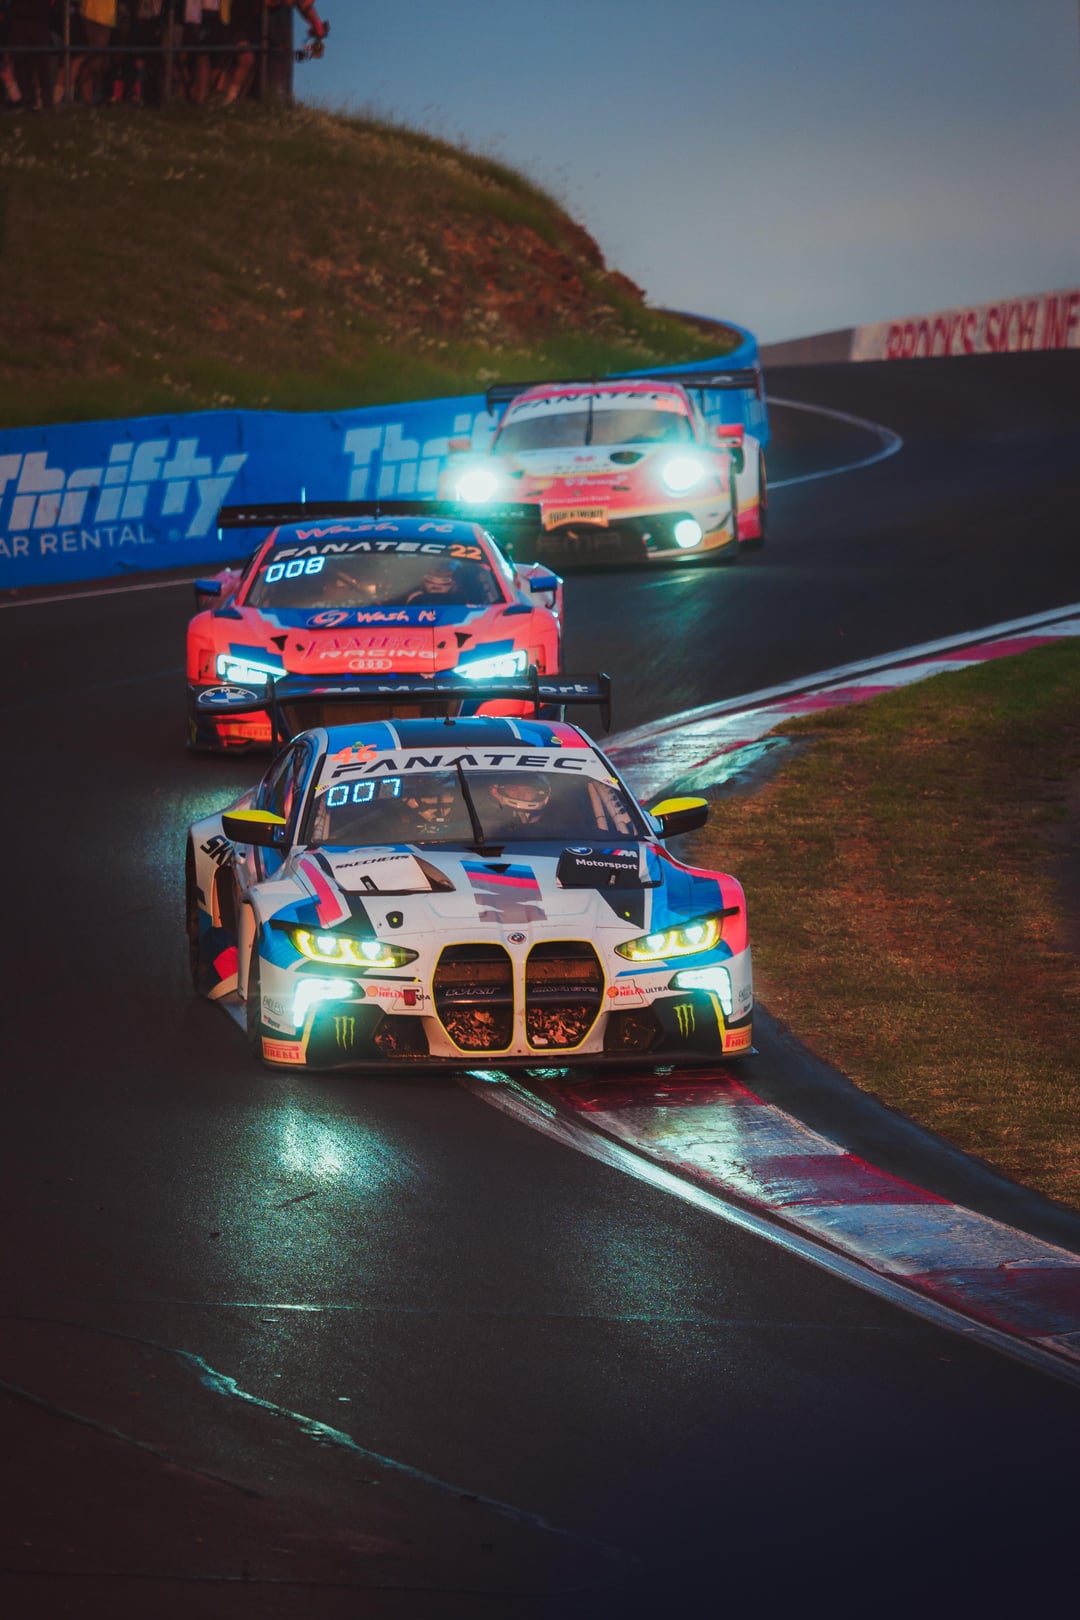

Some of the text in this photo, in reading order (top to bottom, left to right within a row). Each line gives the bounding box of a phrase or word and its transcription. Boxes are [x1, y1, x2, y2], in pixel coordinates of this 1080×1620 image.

[39, 525, 153, 555] RENTAL
[296, 520, 399, 540] Wash
[272, 541, 447, 562] FANATEC
[450, 544, 482, 561] 22
[263, 556, 326, 583] 008
[356, 610, 410, 623] Wash
[319, 649, 438, 660] RACING
[331, 744, 378, 764] 46
[331, 753, 588, 779] FANATEC
[326, 778, 400, 807] 007
[335, 855, 410, 869] SKECHERS
[575, 858, 638, 870] Motorsport
[645, 986, 669, 995] ULTRA
